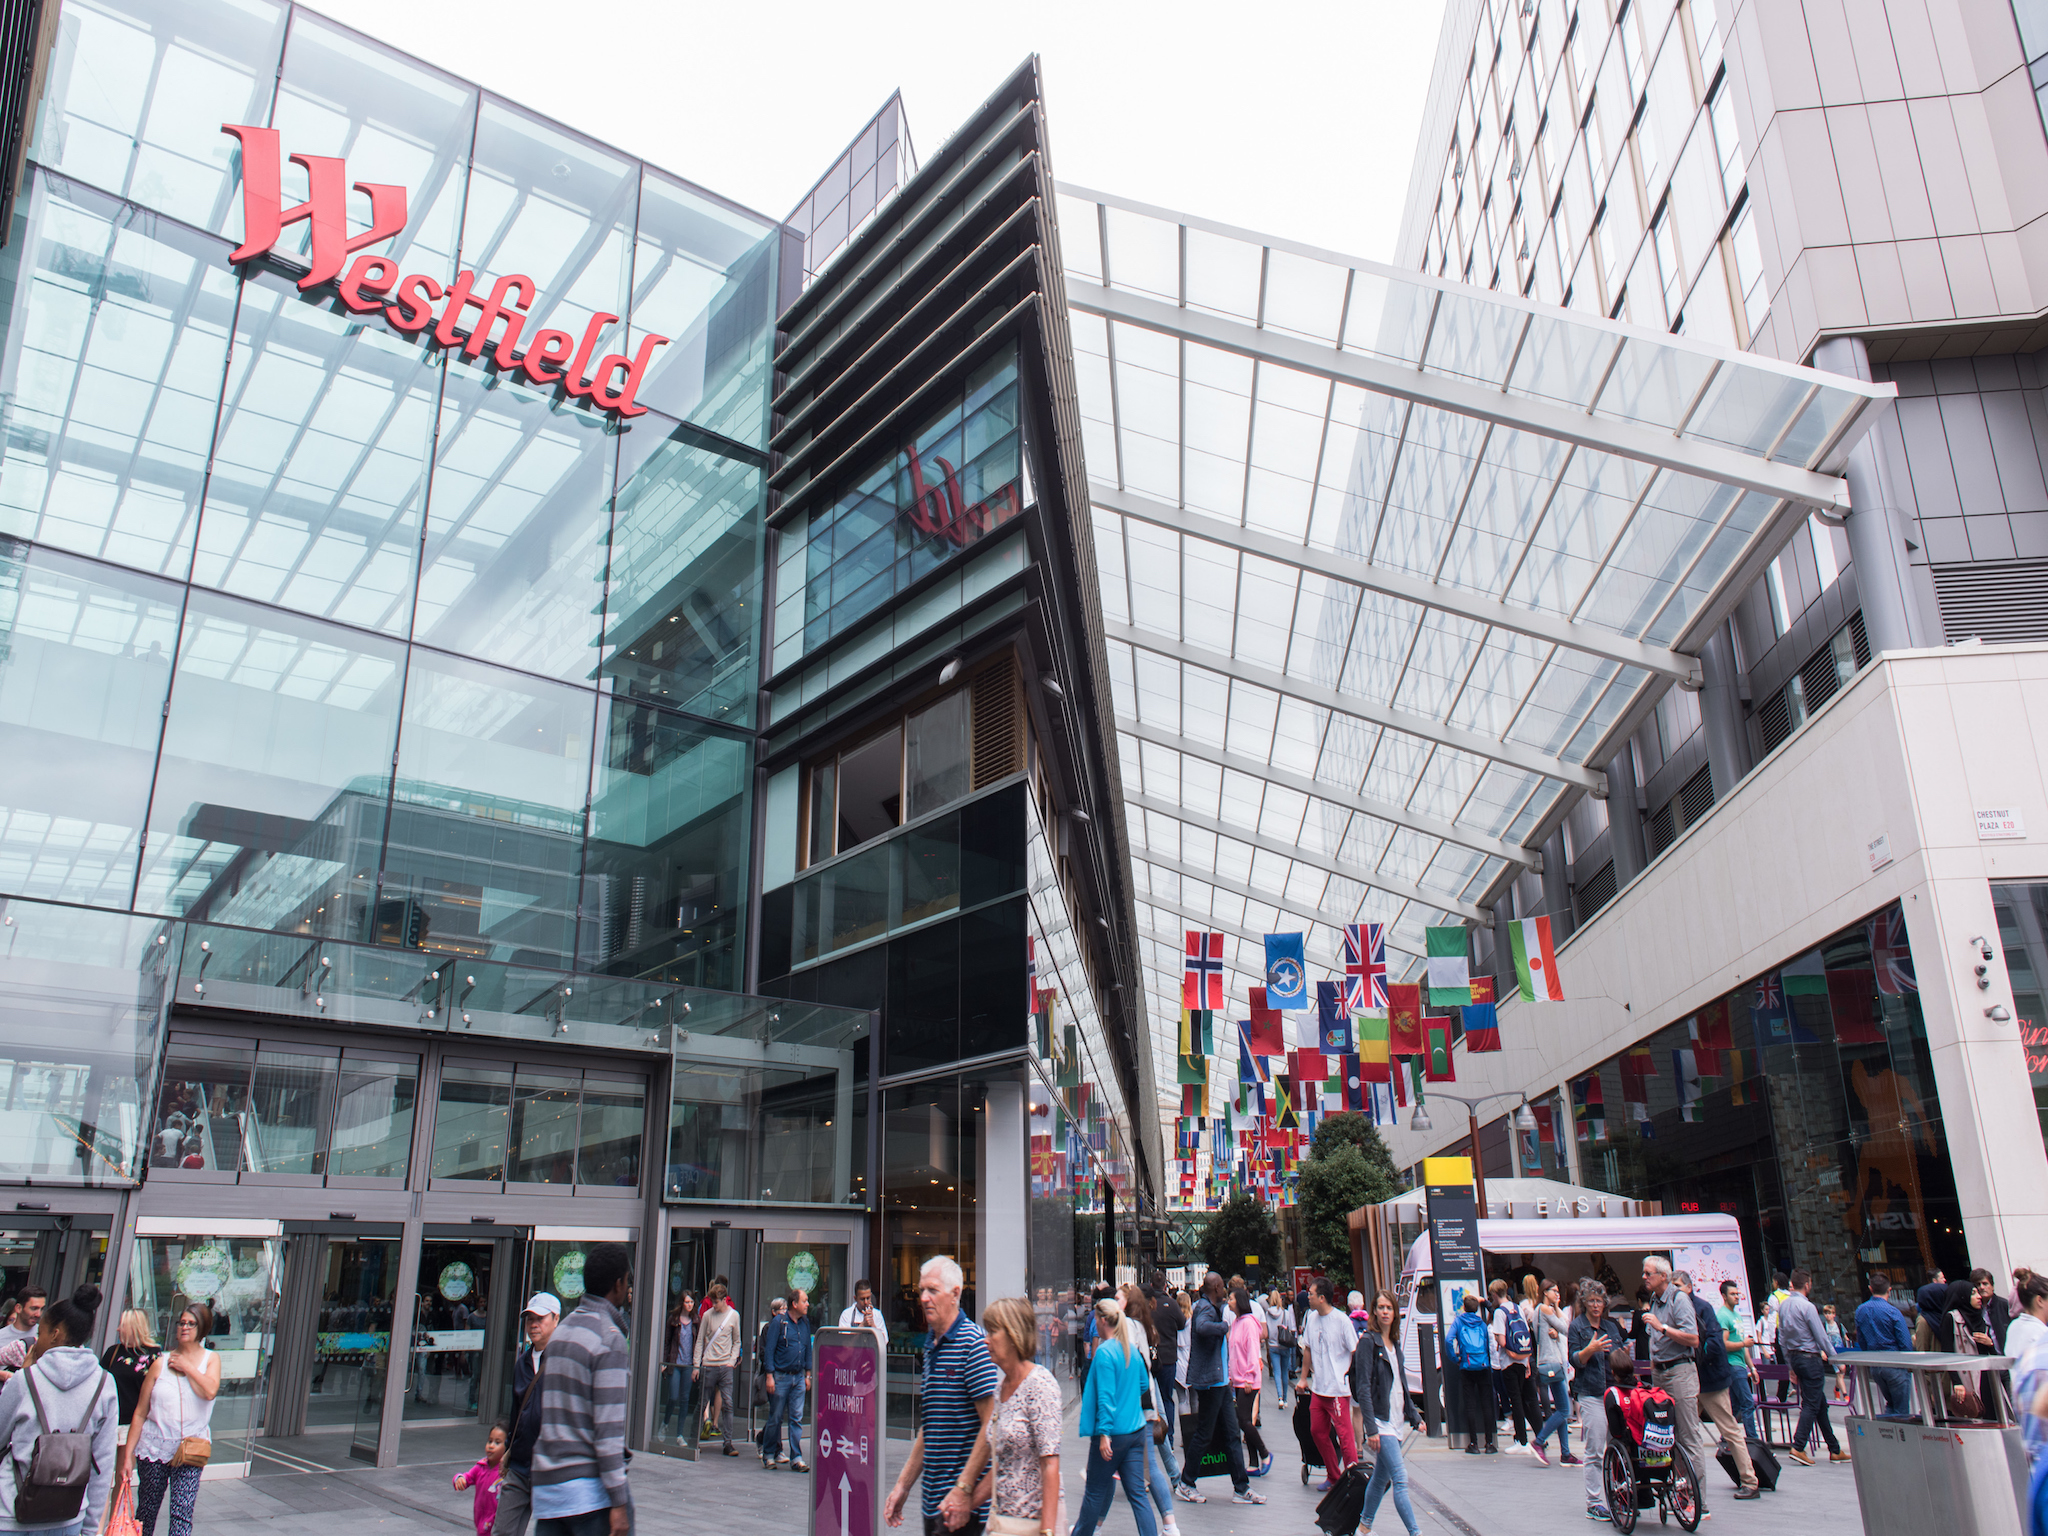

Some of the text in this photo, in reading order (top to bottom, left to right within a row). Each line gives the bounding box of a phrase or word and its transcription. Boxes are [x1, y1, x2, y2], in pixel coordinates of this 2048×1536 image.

[220, 123, 669, 419] Westfield
[1976, 810, 2009, 819] CHESTNUT
[1979, 821, 2015, 830] PLAZA E20
[1536, 1195, 1609, 1215] EAST
[1681, 1202, 1699, 1212] PUB
[834, 1368, 857, 1387] PUBLIC
[827, 1393, 864, 1414] TRANSPORT
[1646, 1422, 1669, 1434] Allianz
[1645, 1434, 1674, 1445] KELLER
[1200, 1451, 1227, 1466] chuh
